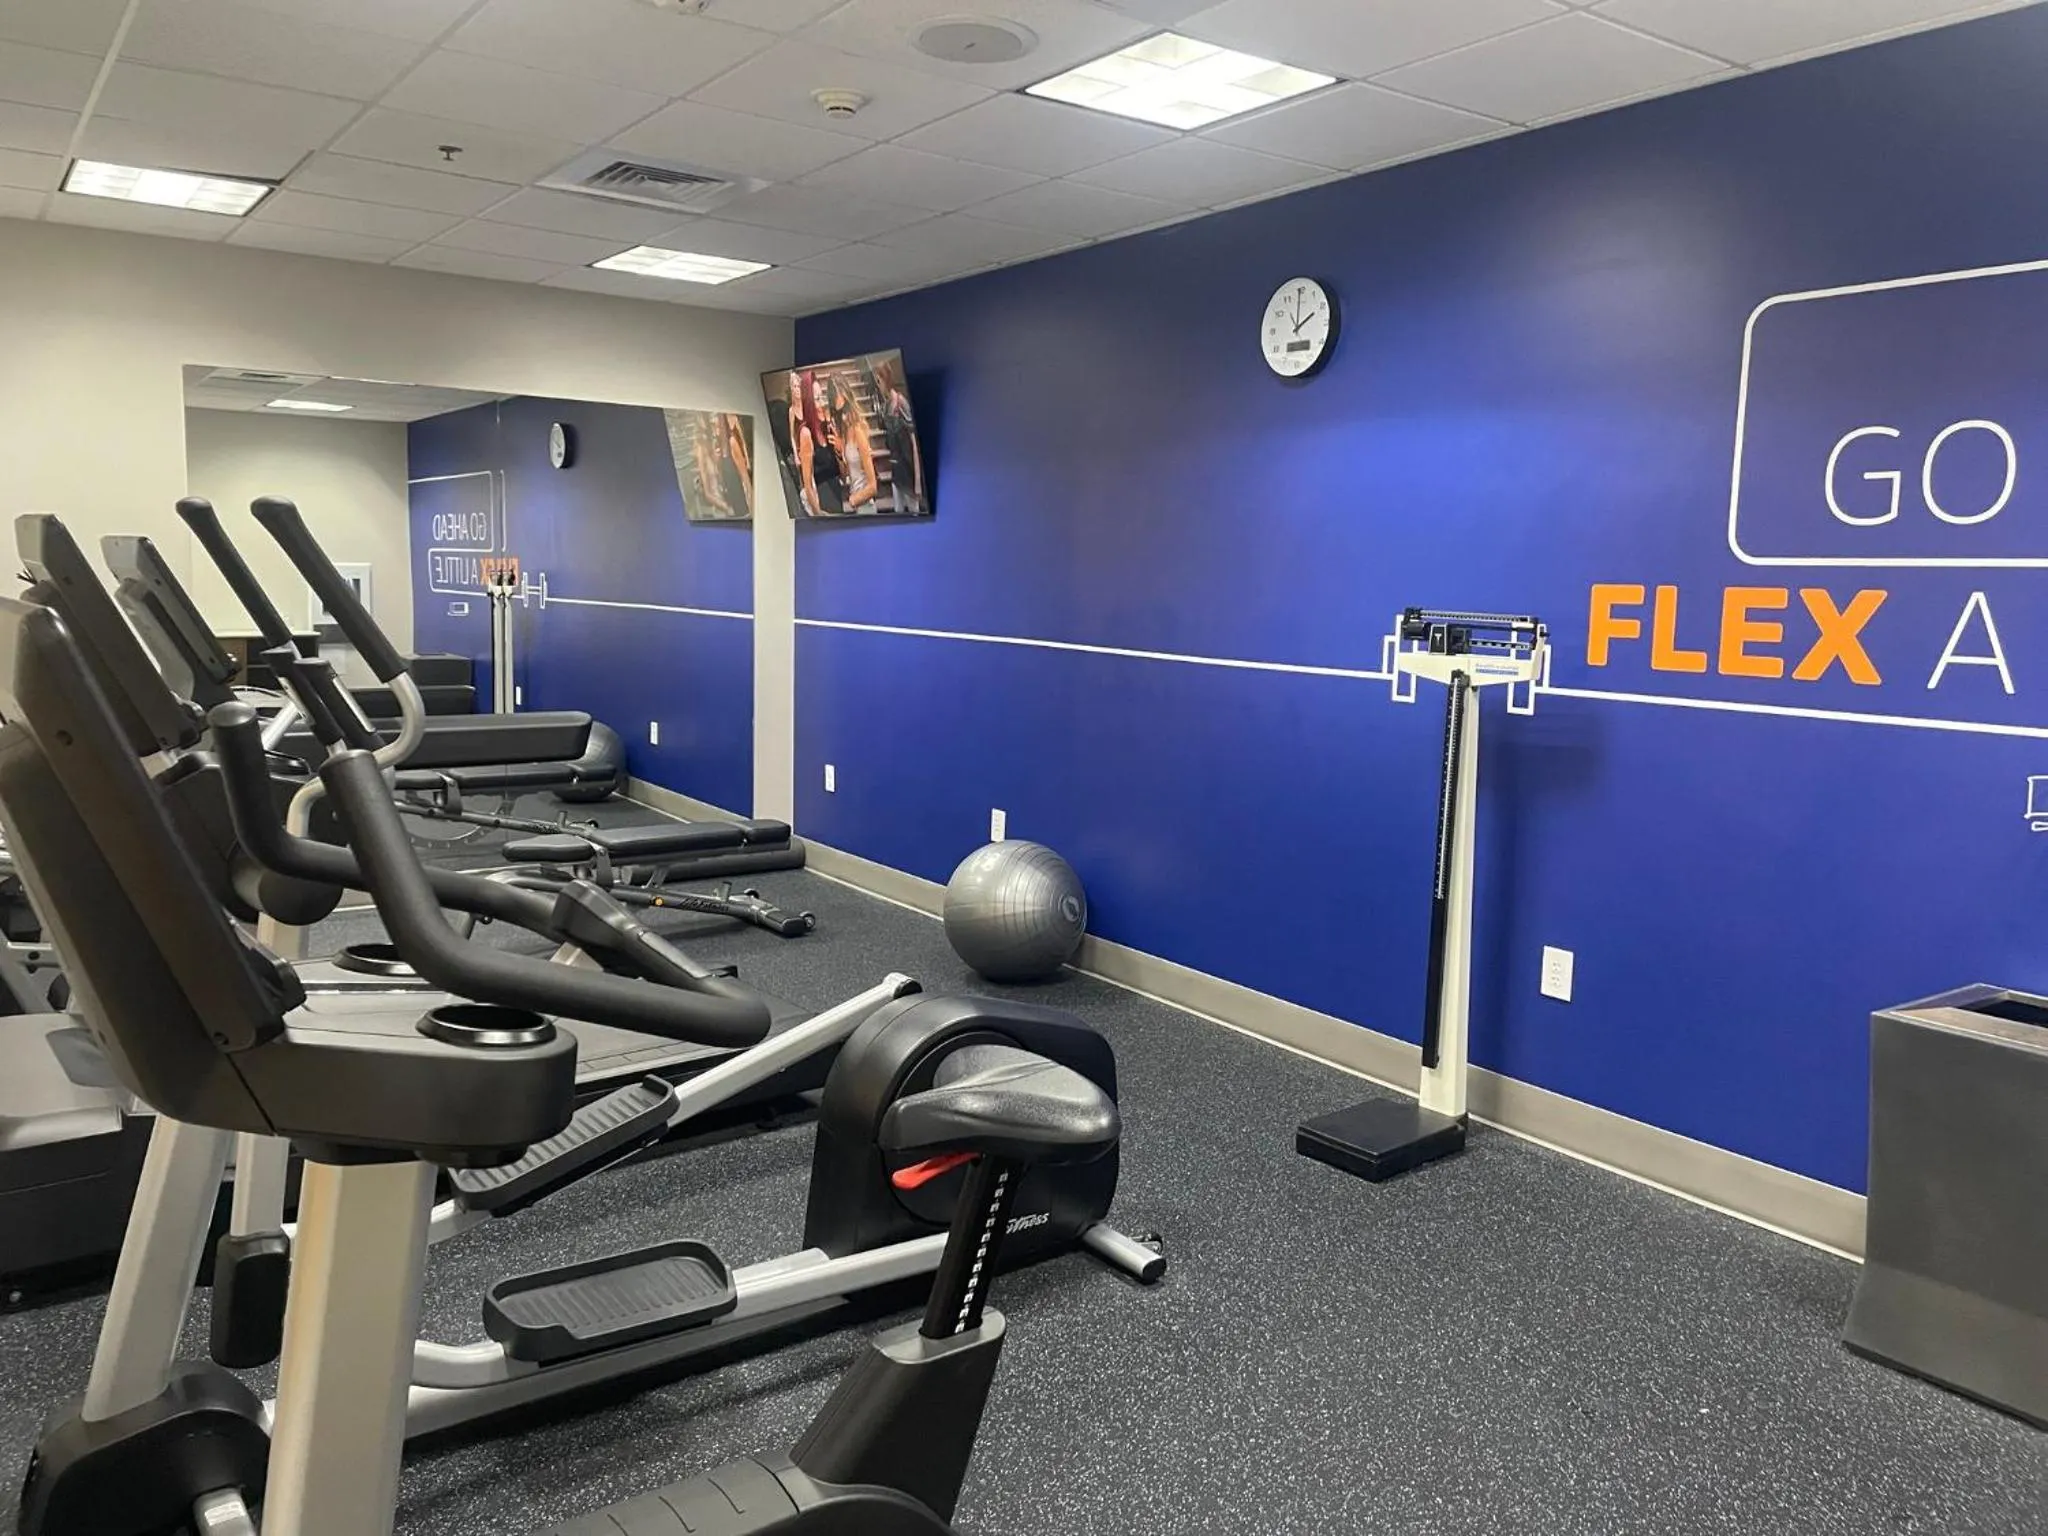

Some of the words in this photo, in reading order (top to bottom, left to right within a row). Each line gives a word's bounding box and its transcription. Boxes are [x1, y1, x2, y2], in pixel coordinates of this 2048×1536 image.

[1824, 419, 2017, 526] GO
[1586, 583, 1888, 686] FLEX
[1927, 591, 2016, 695] A
